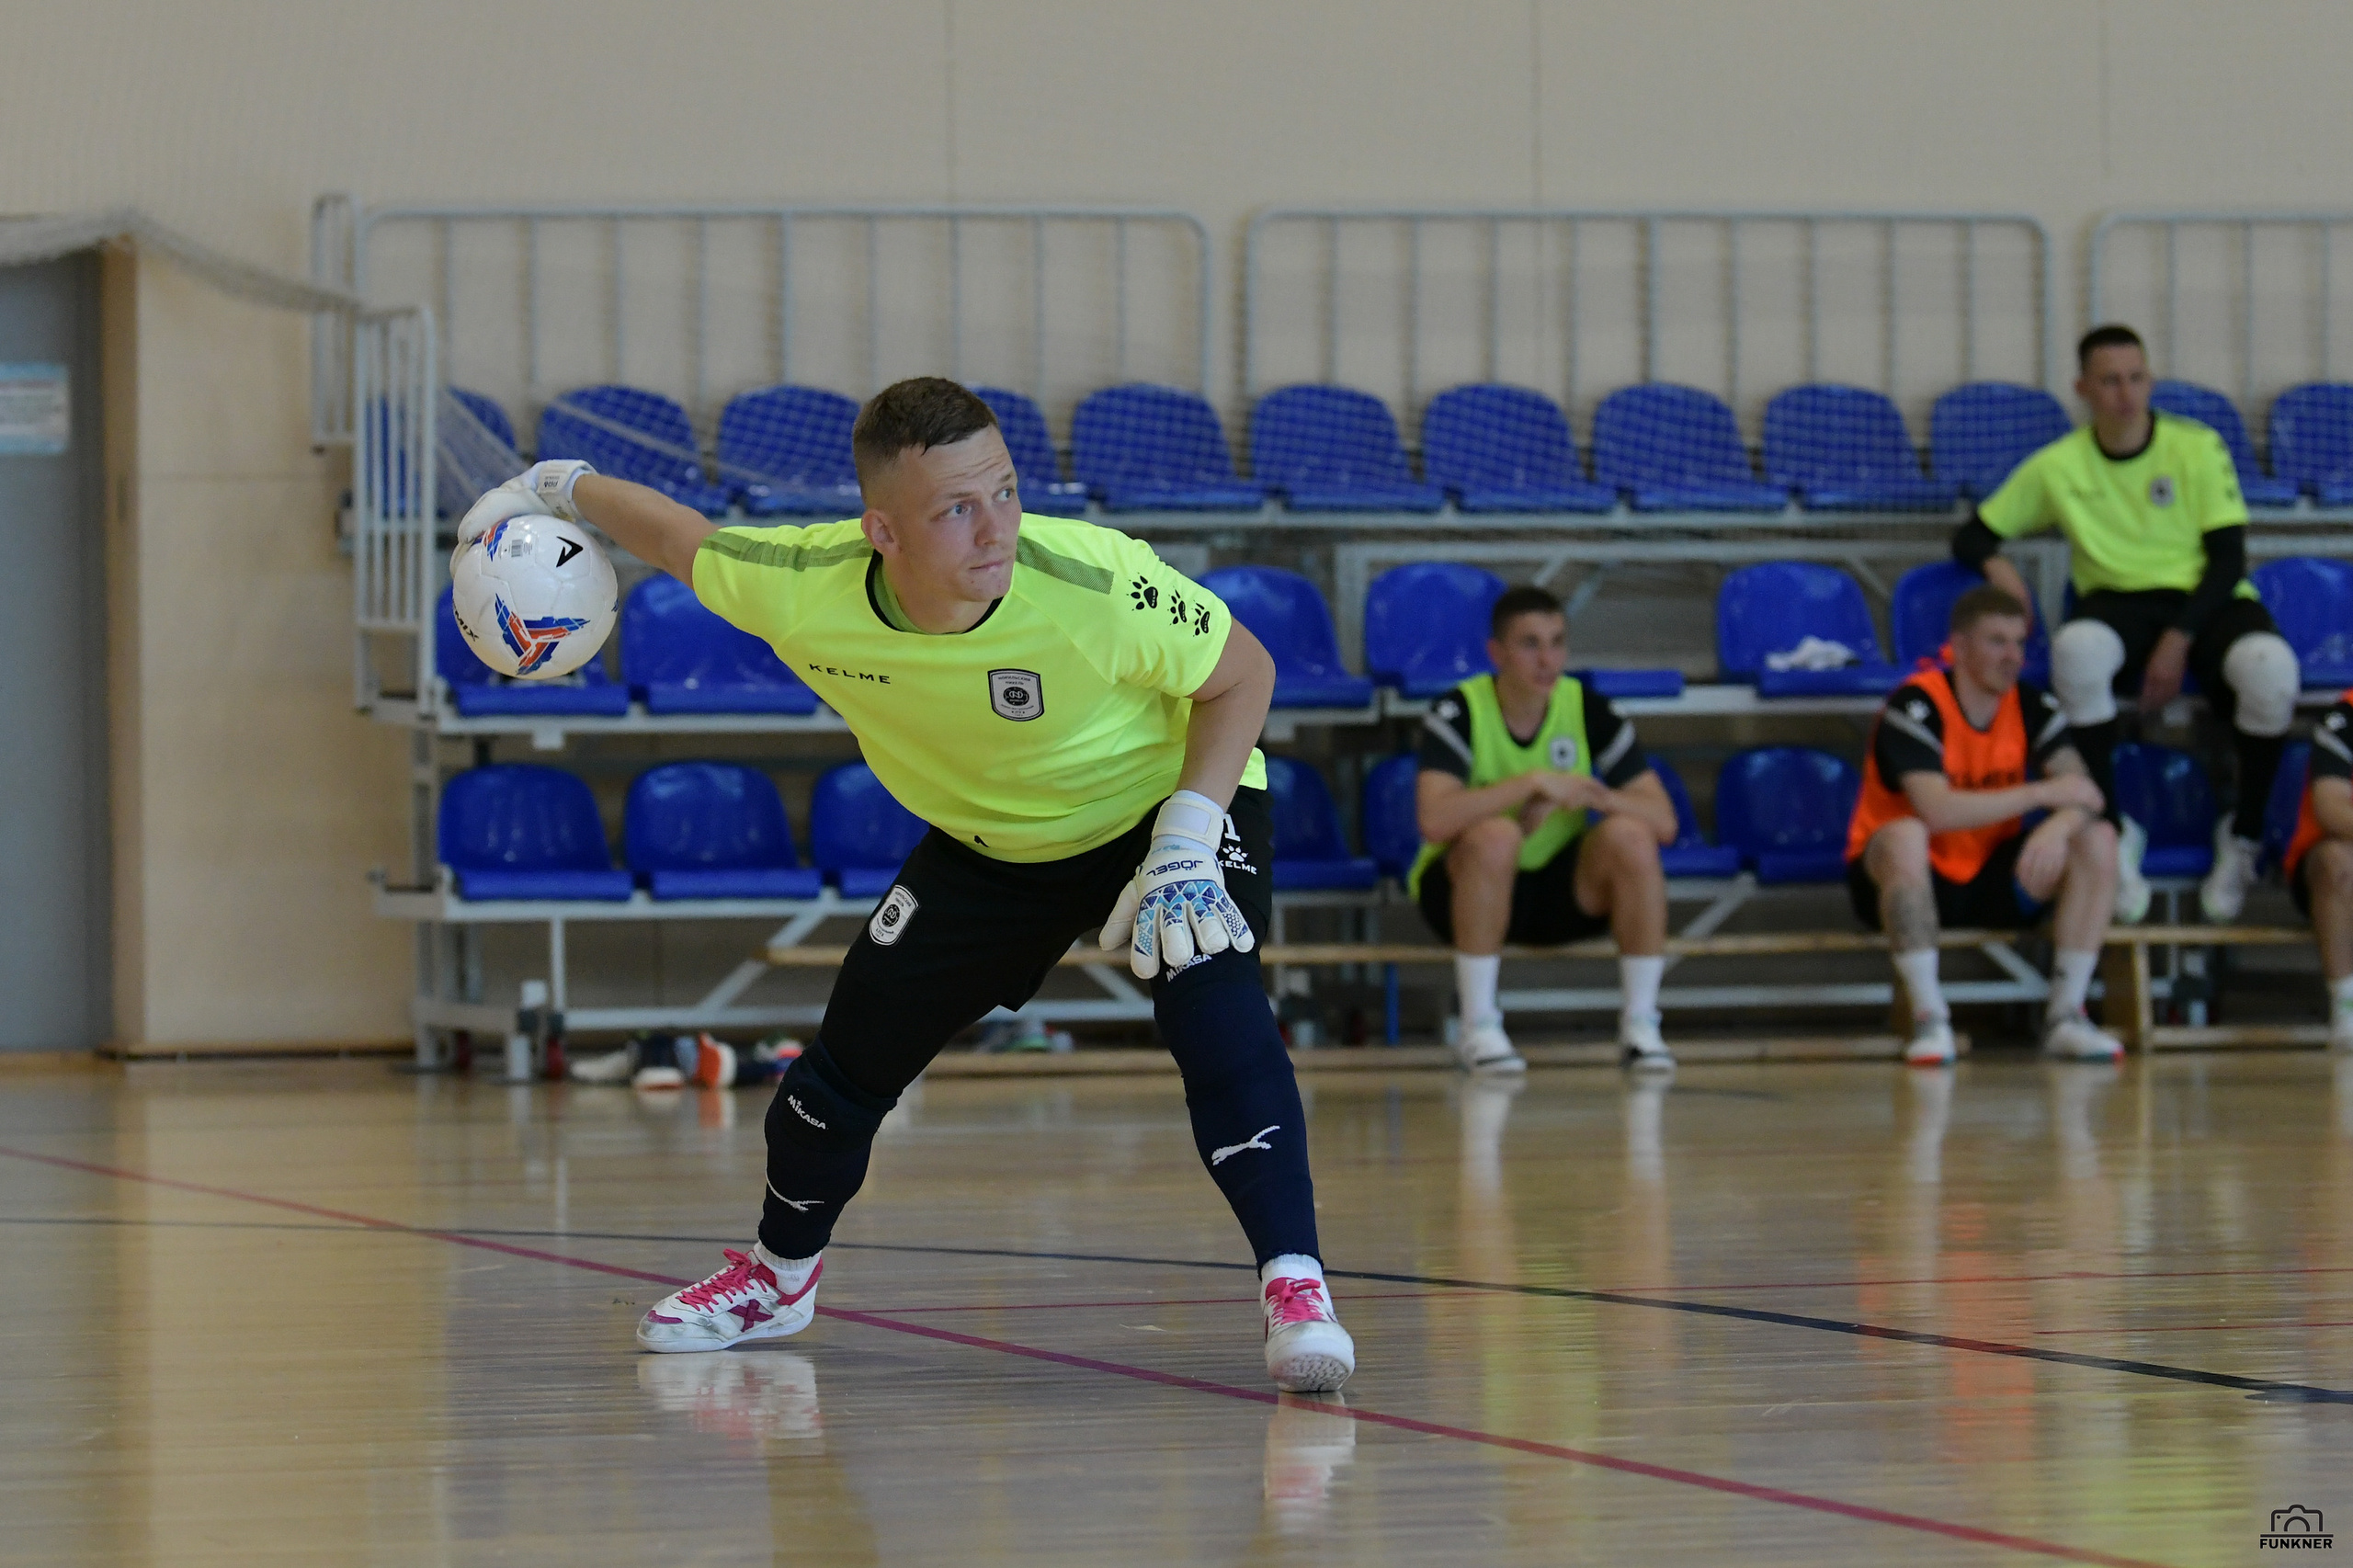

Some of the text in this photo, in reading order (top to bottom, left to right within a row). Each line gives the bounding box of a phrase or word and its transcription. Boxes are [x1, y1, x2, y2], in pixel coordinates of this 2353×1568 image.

[453, 603, 479, 642] MIX
[809, 663, 891, 684] KELME
[1146, 860, 1203, 876] JÖGEL
[1218, 860, 1256, 875] KELME
